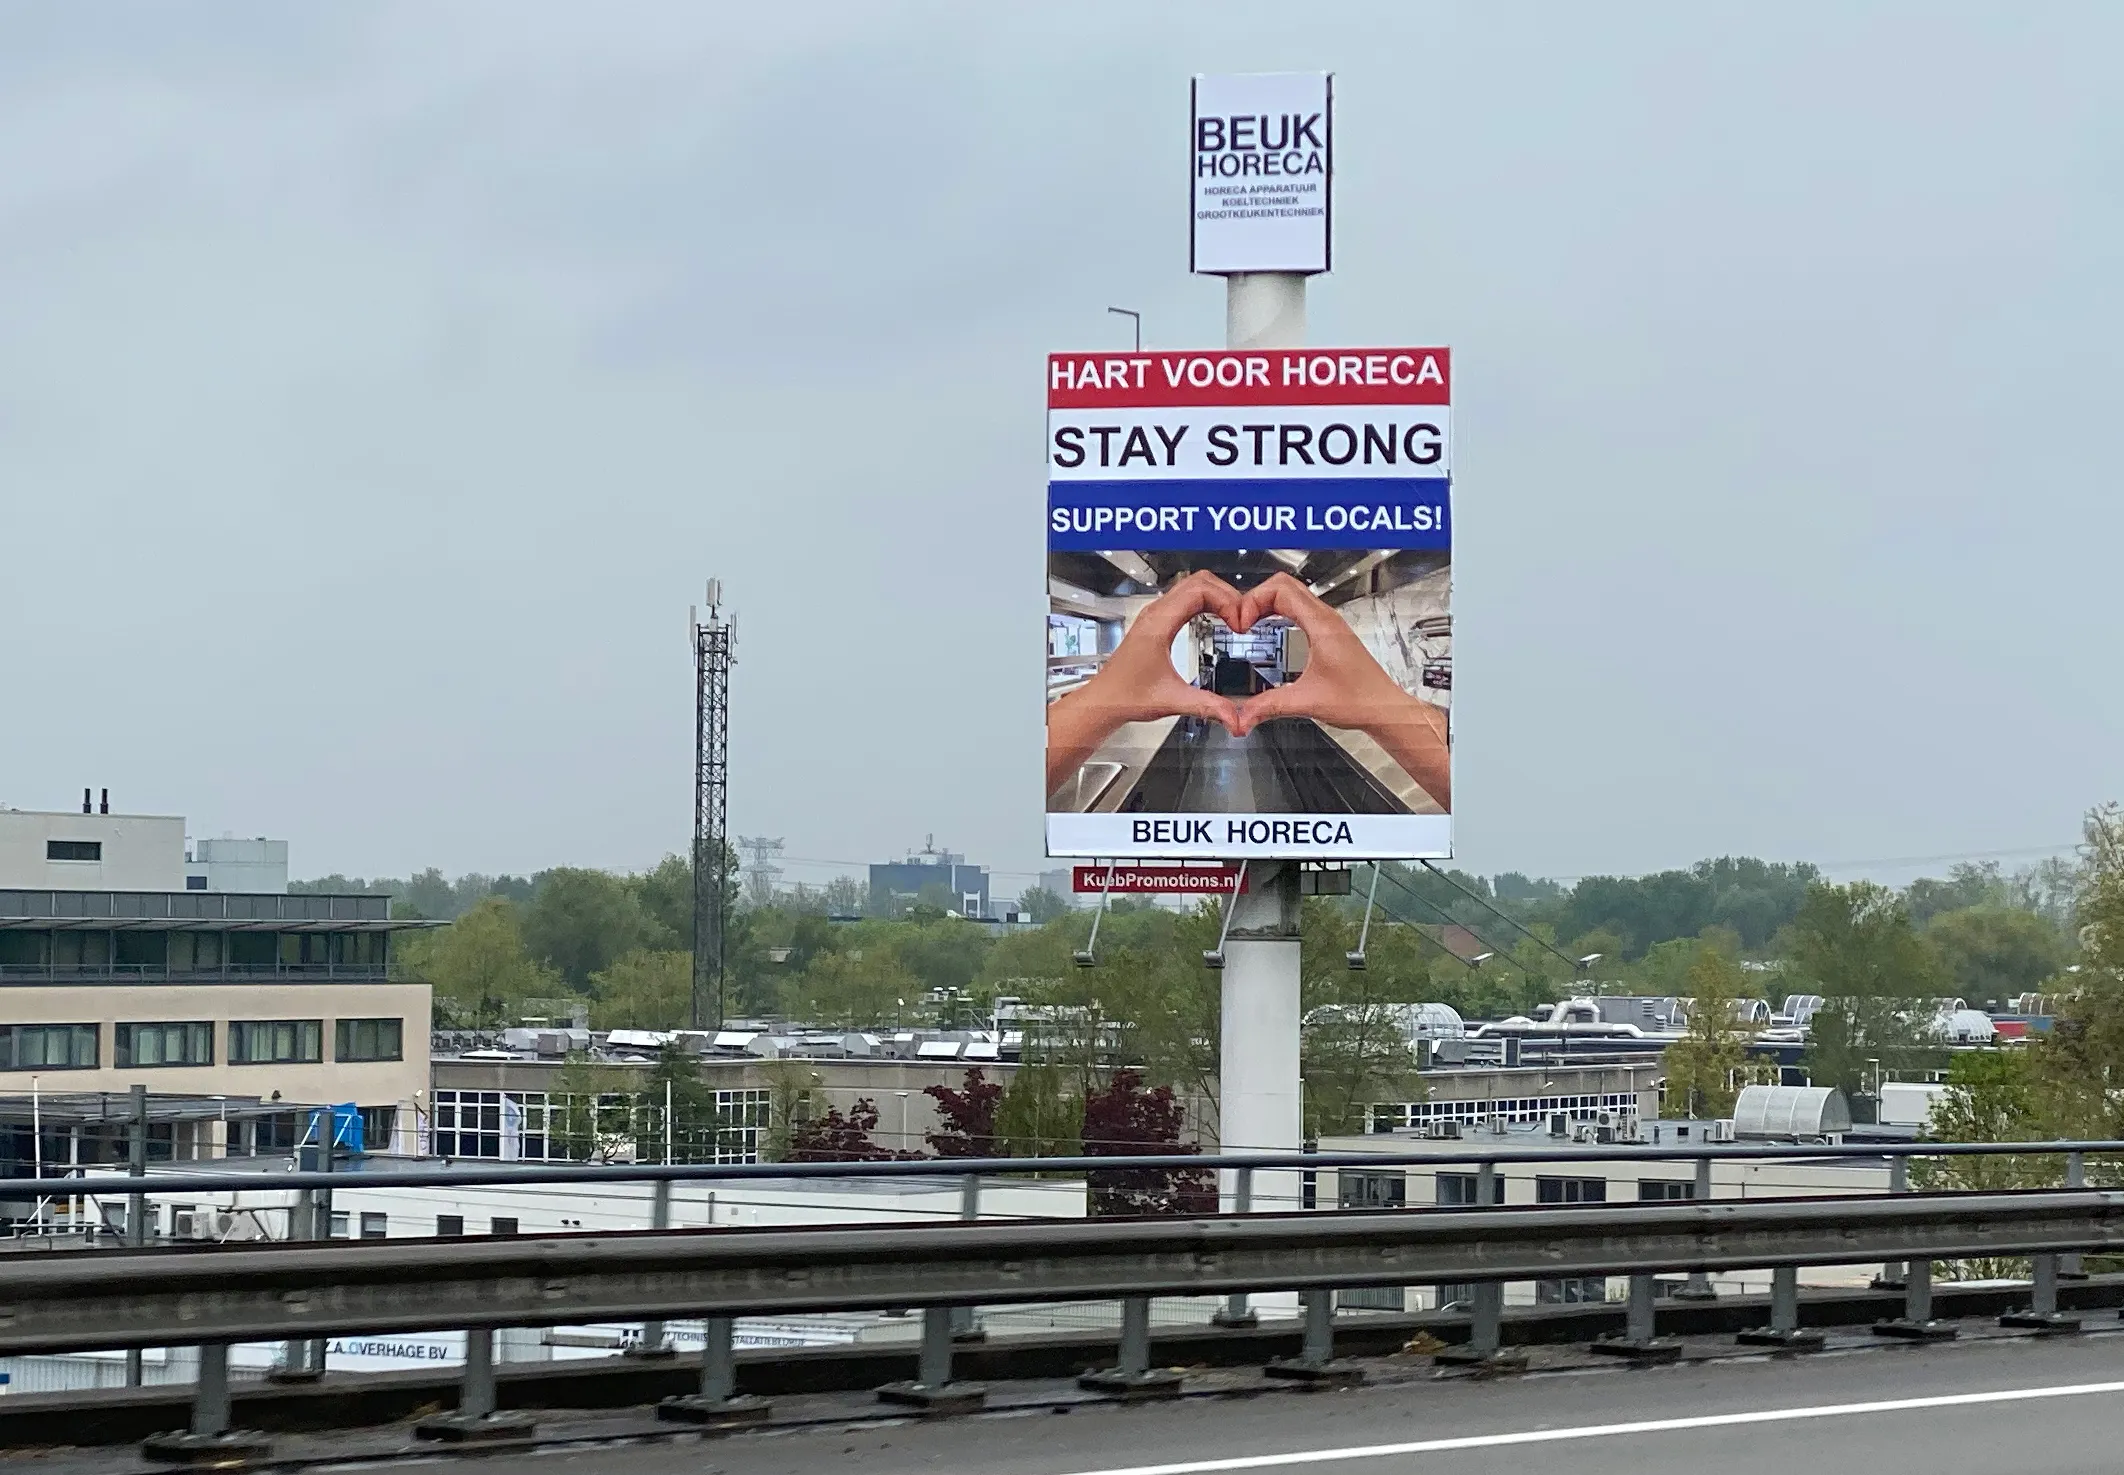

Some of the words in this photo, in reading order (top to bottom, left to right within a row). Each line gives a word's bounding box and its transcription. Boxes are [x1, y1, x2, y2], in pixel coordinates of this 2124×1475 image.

[1198, 113, 1323, 152] BEUK
[1198, 151, 1323, 177] HORECA
[1204, 185, 1247, 195] HORECA
[1249, 183, 1317, 193] APPARATUUR
[1222, 196, 1299, 207] KOELTECHNIEK
[1197, 207, 1324, 219] GROOTKEUKENTECHNIEK
[1051, 358, 1152, 390] HART
[1162, 358, 1270, 388] VOOR
[1284, 355, 1443, 386] HORECA
[1053, 425, 1189, 468] STAY
[1206, 423, 1442, 467] STRONG
[1051, 507, 1199, 532] SUPPORT
[1206, 506, 1296, 531] YOUR
[1306, 505, 1442, 531] LOCALS!
[1133, 820, 1213, 844] BEUK
[1227, 820, 1353, 845] HORECA
[349, 1342, 425, 1358] OVERHAGE
[428, 1346, 447, 1360] BV
